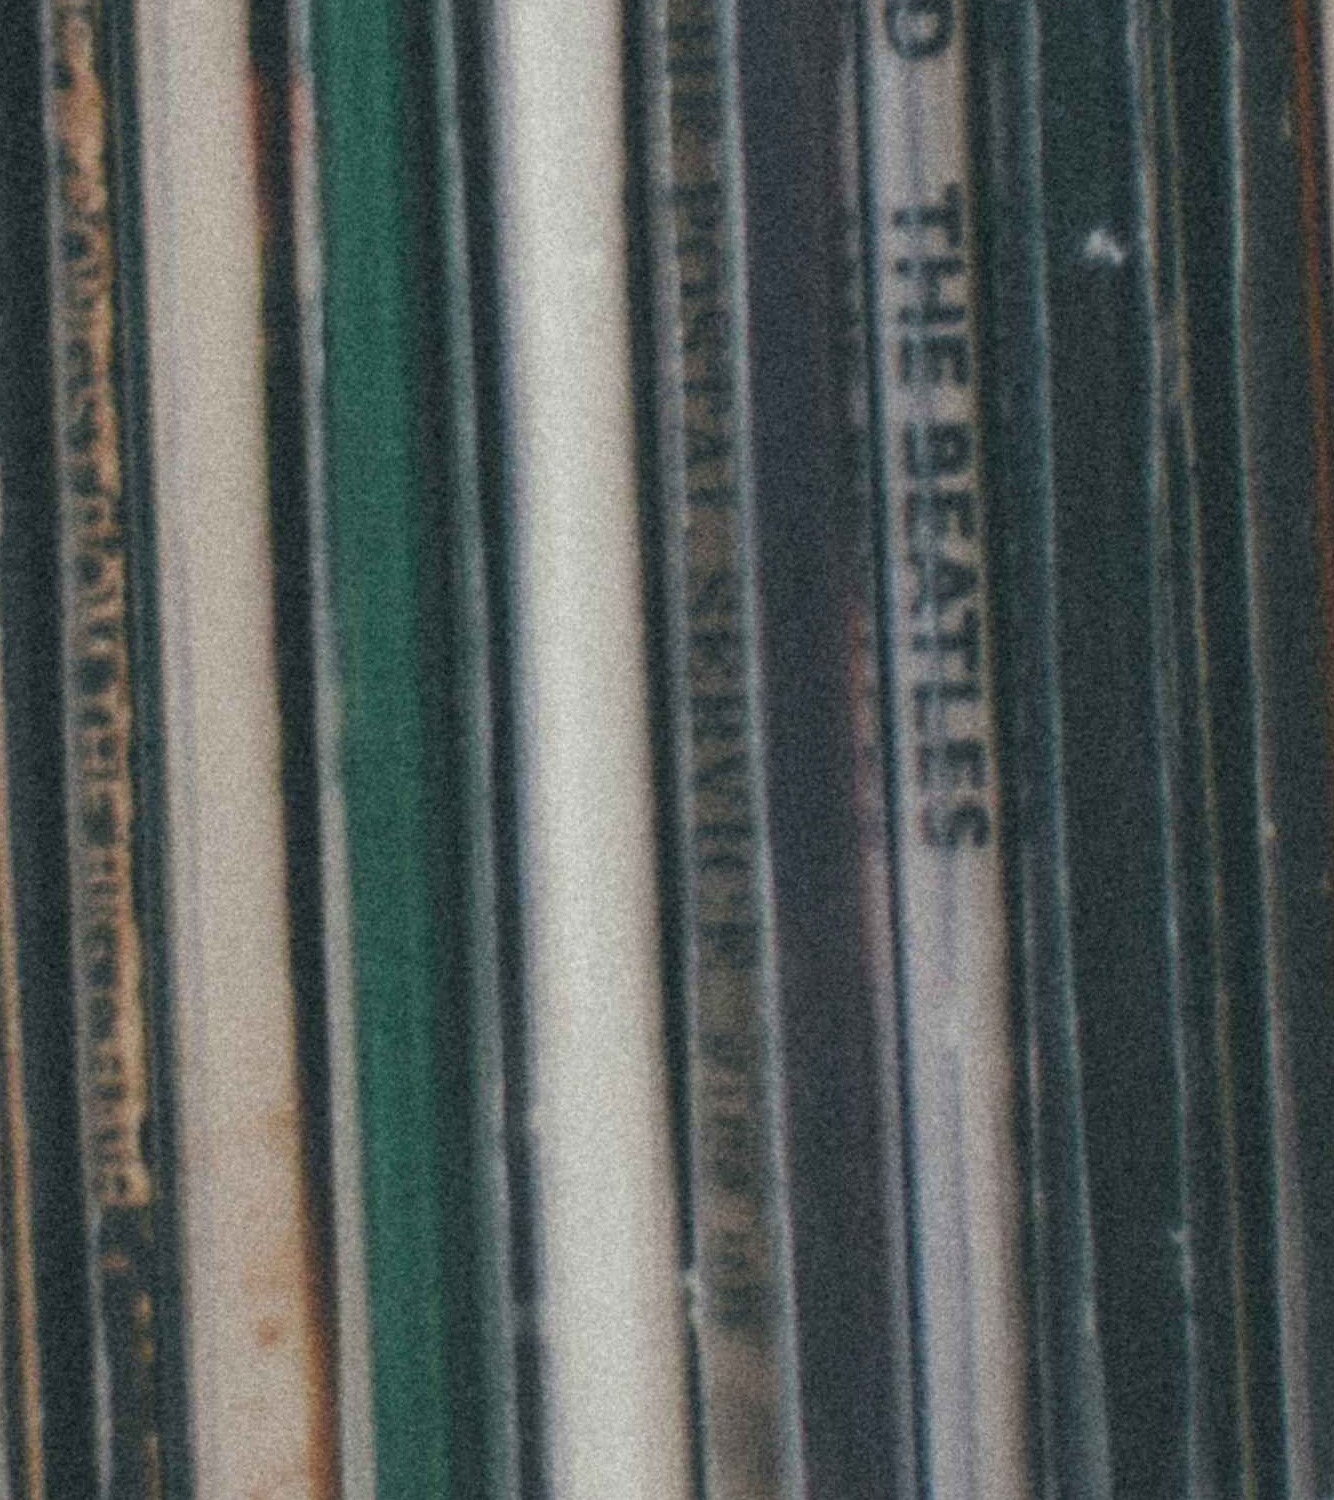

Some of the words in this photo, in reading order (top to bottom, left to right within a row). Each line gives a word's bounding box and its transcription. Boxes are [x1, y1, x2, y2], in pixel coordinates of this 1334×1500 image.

[675, 184, 741, 516] POSTAL
[889, 185, 971, 387] THE
[687, 566, 759, 972] SERVICE
[901, 422, 991, 852] BEATLES
